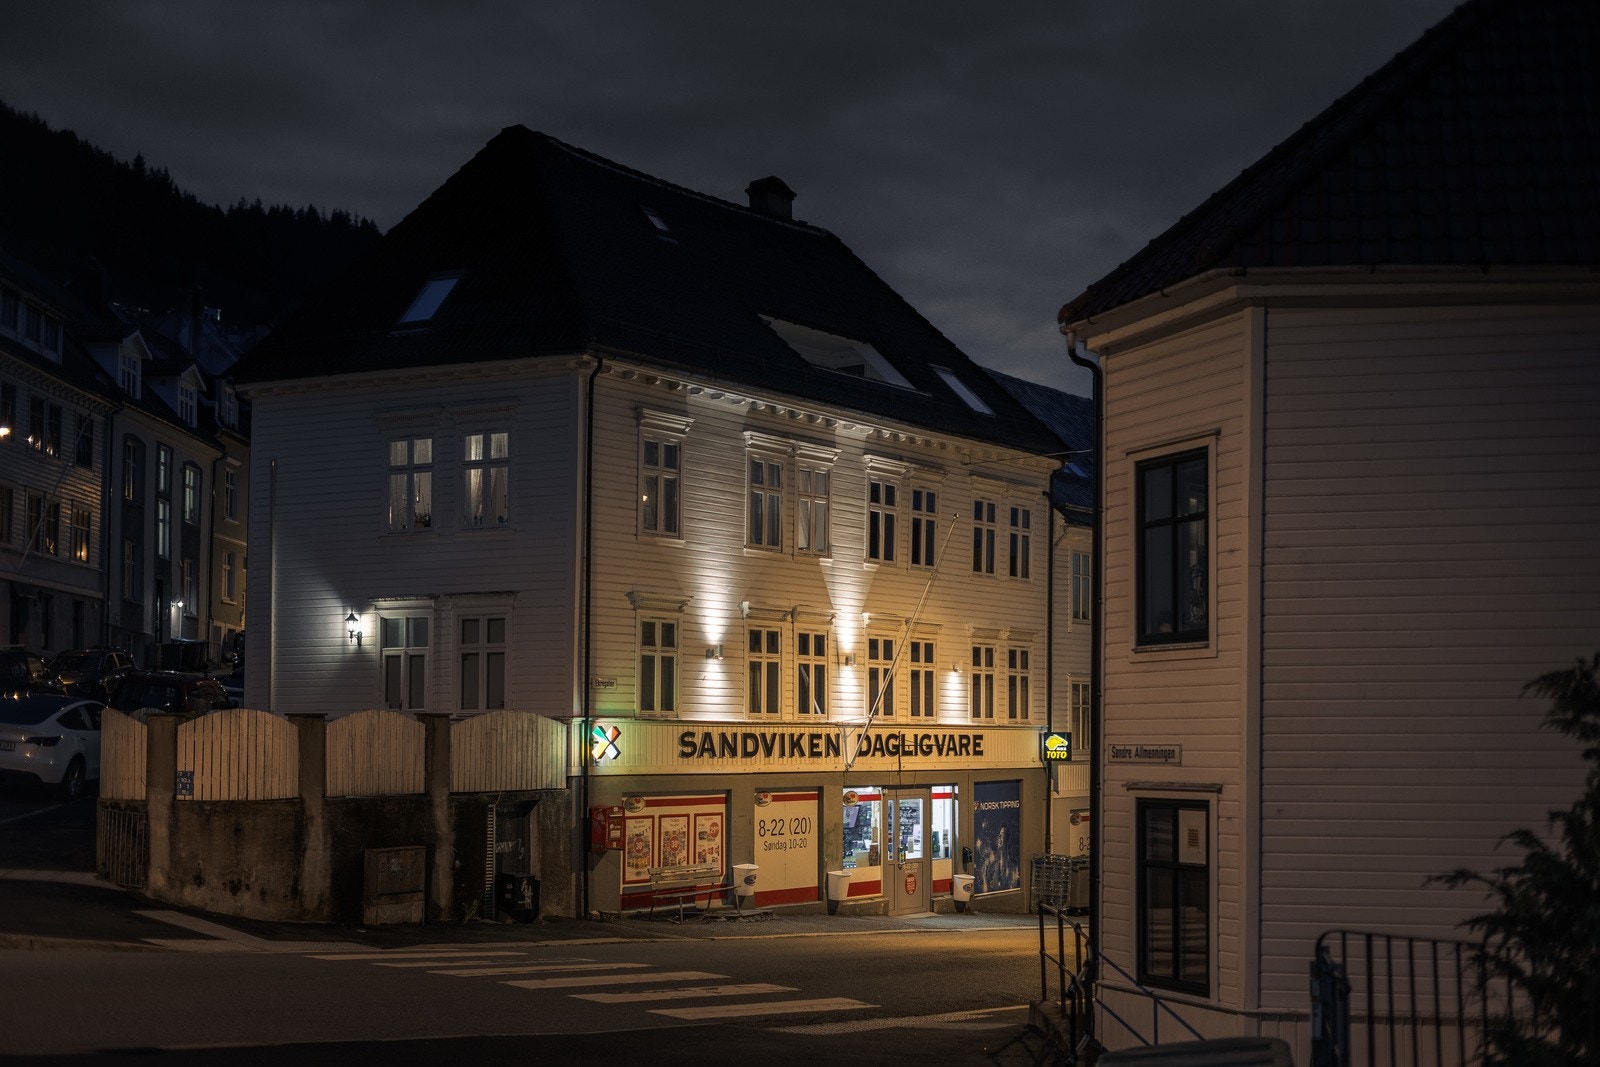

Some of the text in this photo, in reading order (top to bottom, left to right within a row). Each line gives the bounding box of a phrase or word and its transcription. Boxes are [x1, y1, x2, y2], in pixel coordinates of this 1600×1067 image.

[679, 731, 983, 758] SANDVIKEN DAGLIGVARE
[1046, 751, 1067, 759] TOTO
[980, 800, 1020, 810] NORSK TIPPING
[758, 817, 812, 837] 8-22 (20)
[763, 837, 808, 852] Søndag 10-20
